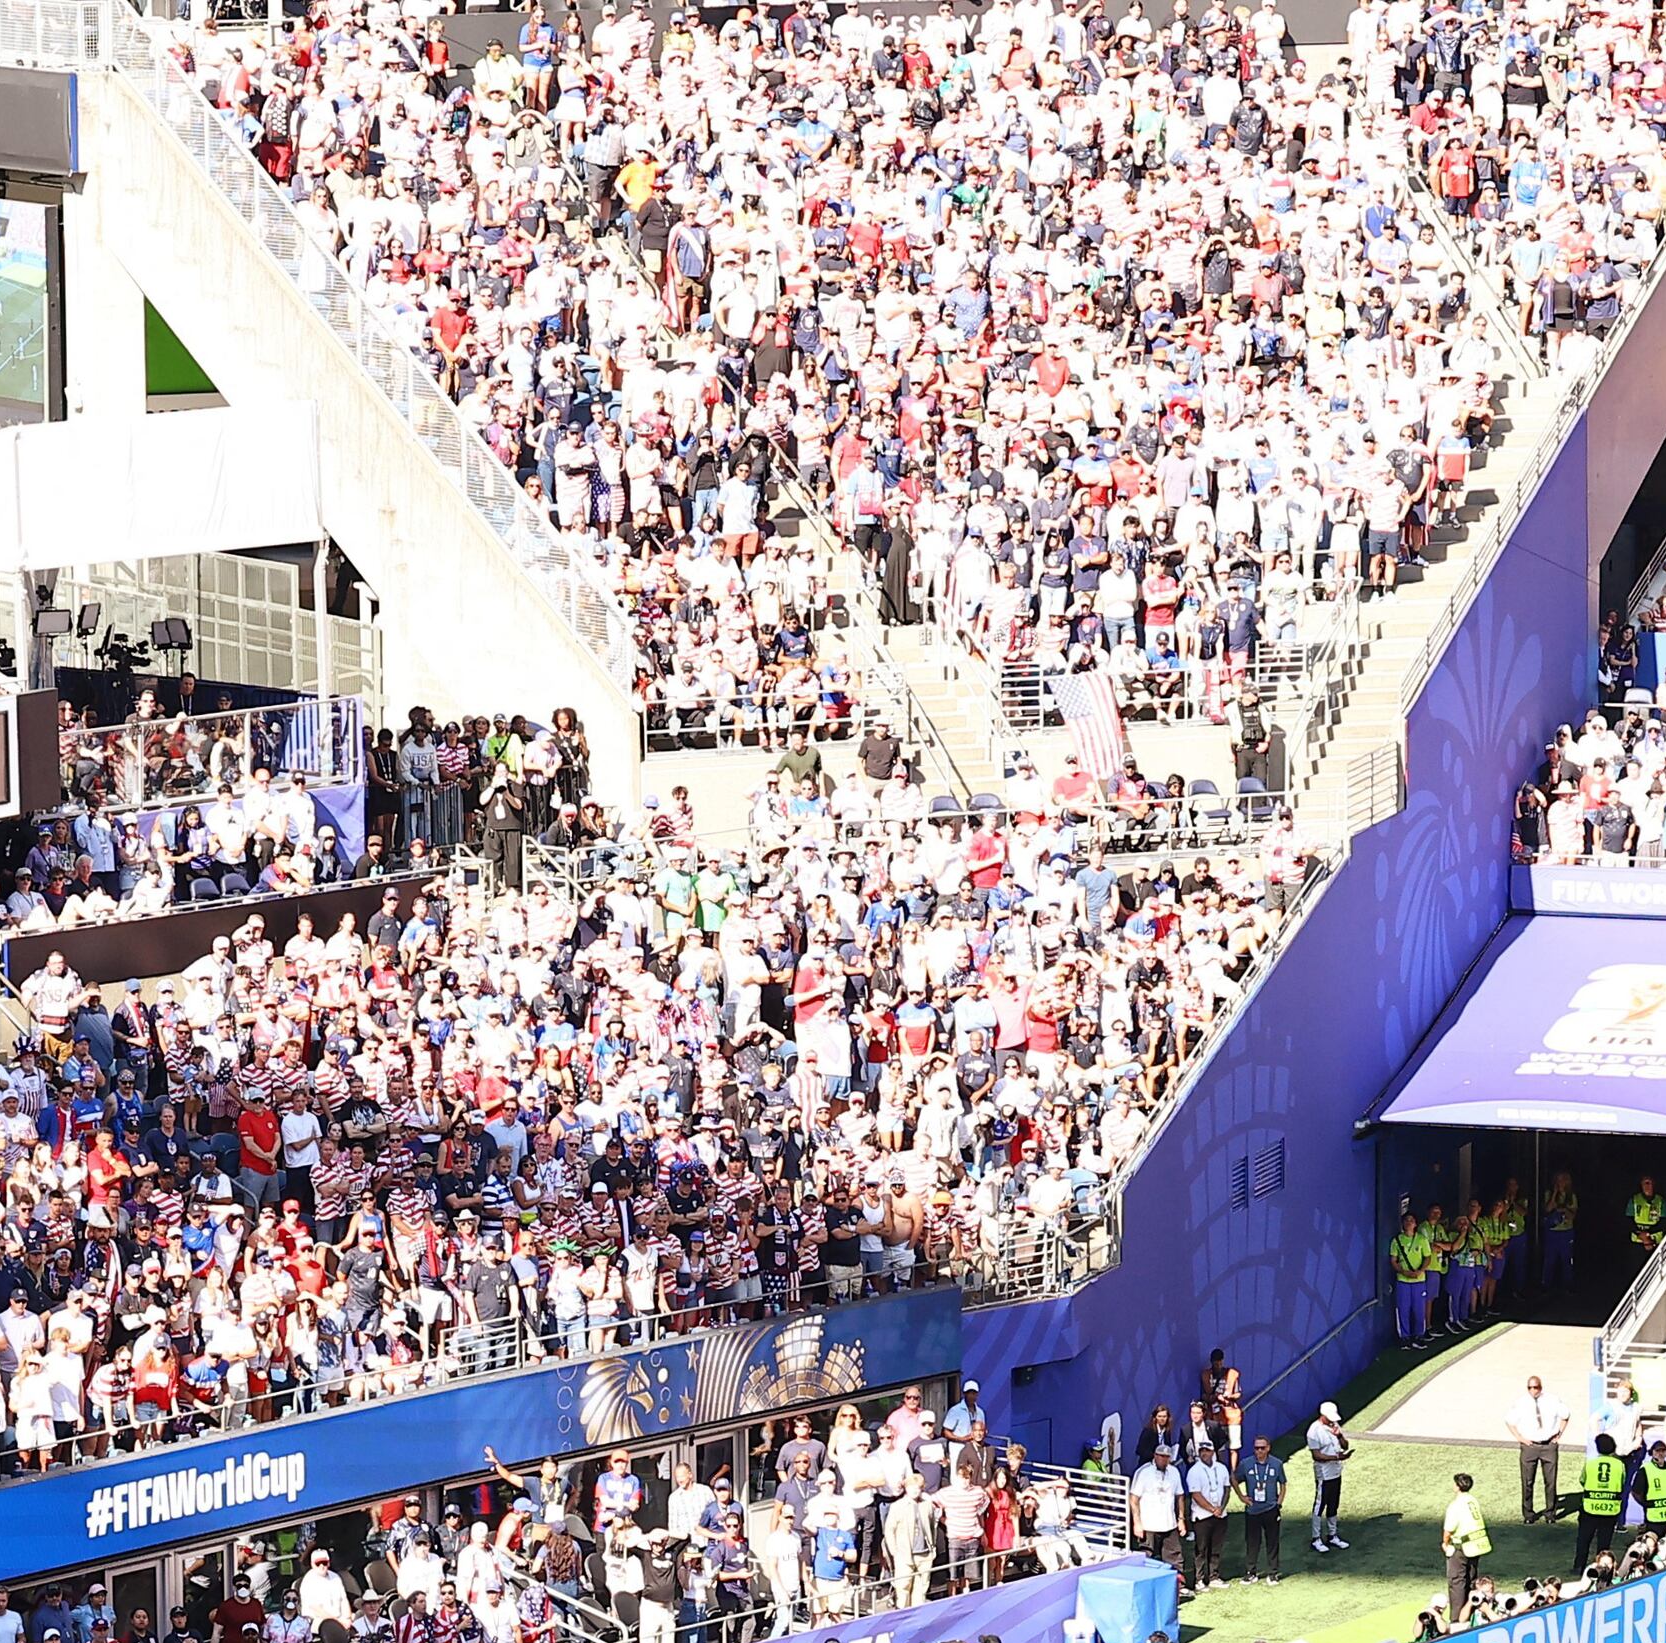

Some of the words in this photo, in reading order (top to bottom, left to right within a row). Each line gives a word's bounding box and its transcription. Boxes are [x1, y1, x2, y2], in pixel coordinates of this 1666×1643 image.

[1551, 879, 1606, 905] FIFA
[1588, 1035, 1653, 1046] FIFA
[1530, 1052, 1627, 1064] WORLD
[85, 1451, 306, 1538] #FIFAWorldCup
